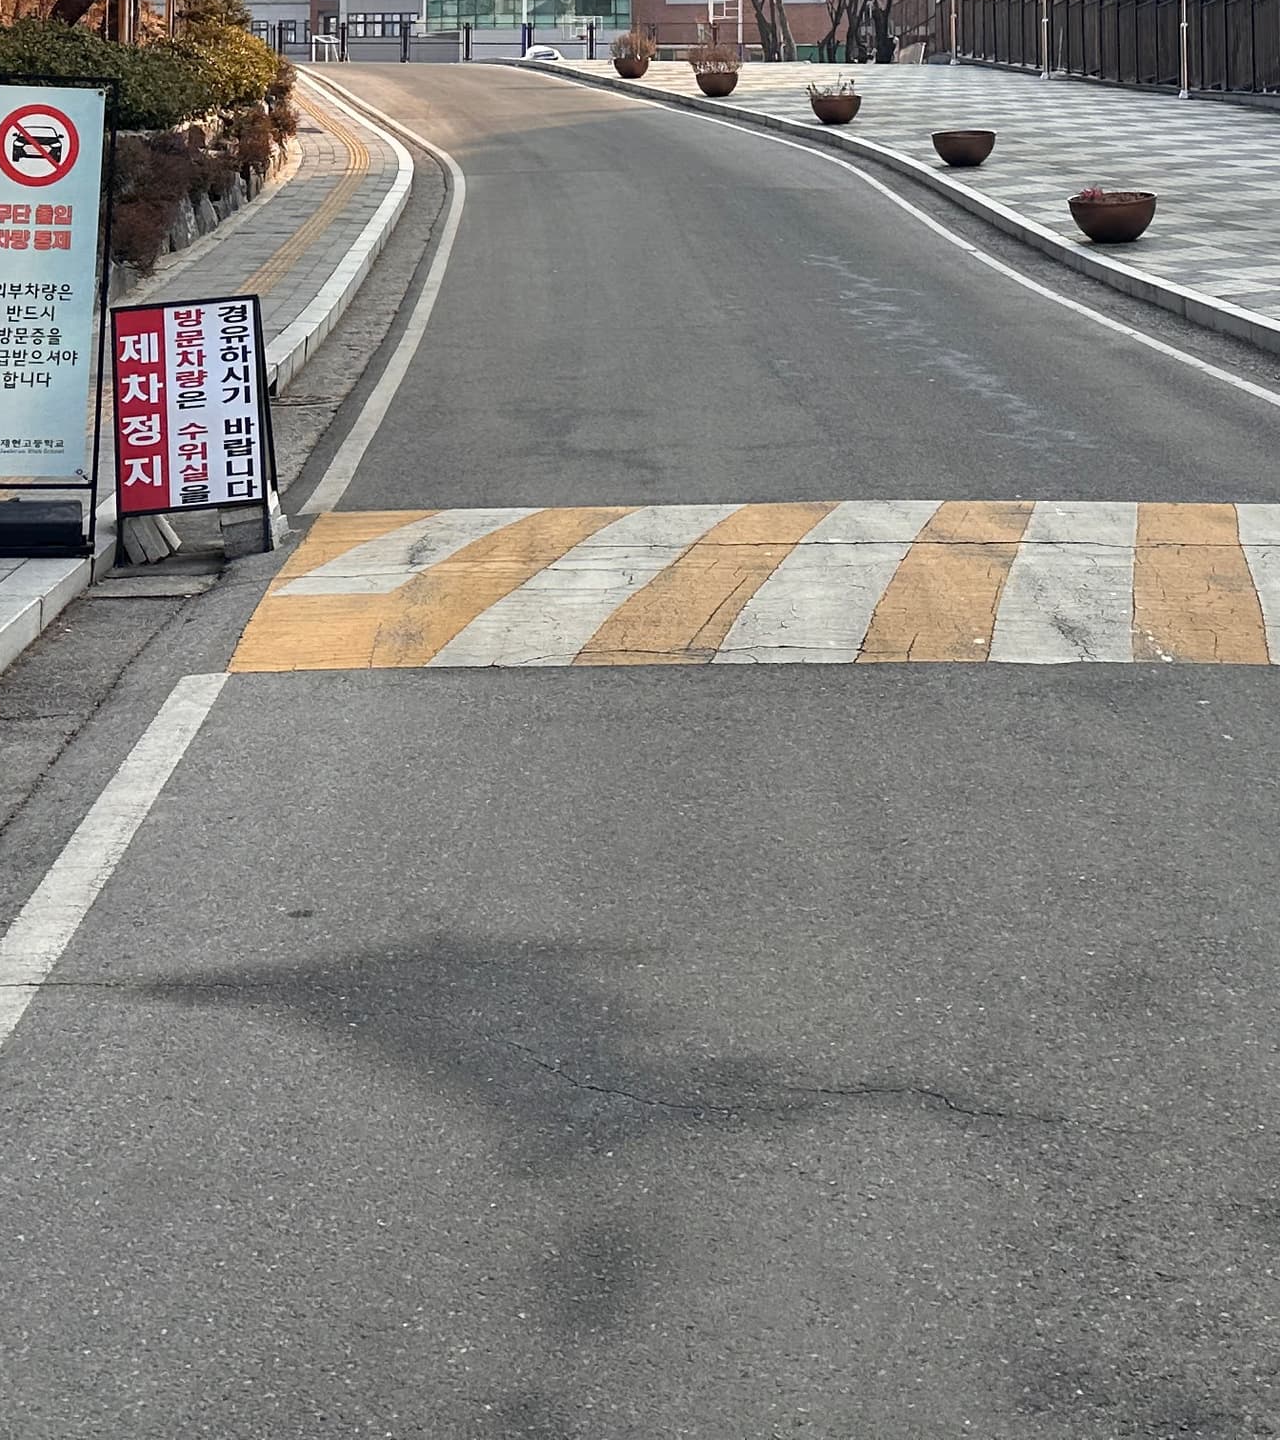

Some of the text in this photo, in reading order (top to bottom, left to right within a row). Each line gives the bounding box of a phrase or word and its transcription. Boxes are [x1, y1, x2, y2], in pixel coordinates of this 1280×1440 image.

[2, 371, 52, 390] 합니다
[6, 305, 56, 323] 반드시
[119, 332, 164, 488] 제차정지
[173, 308, 210, 505] 방문차량은 수위실을
[217, 304, 258, 498] 경유하시기 바랍니다
